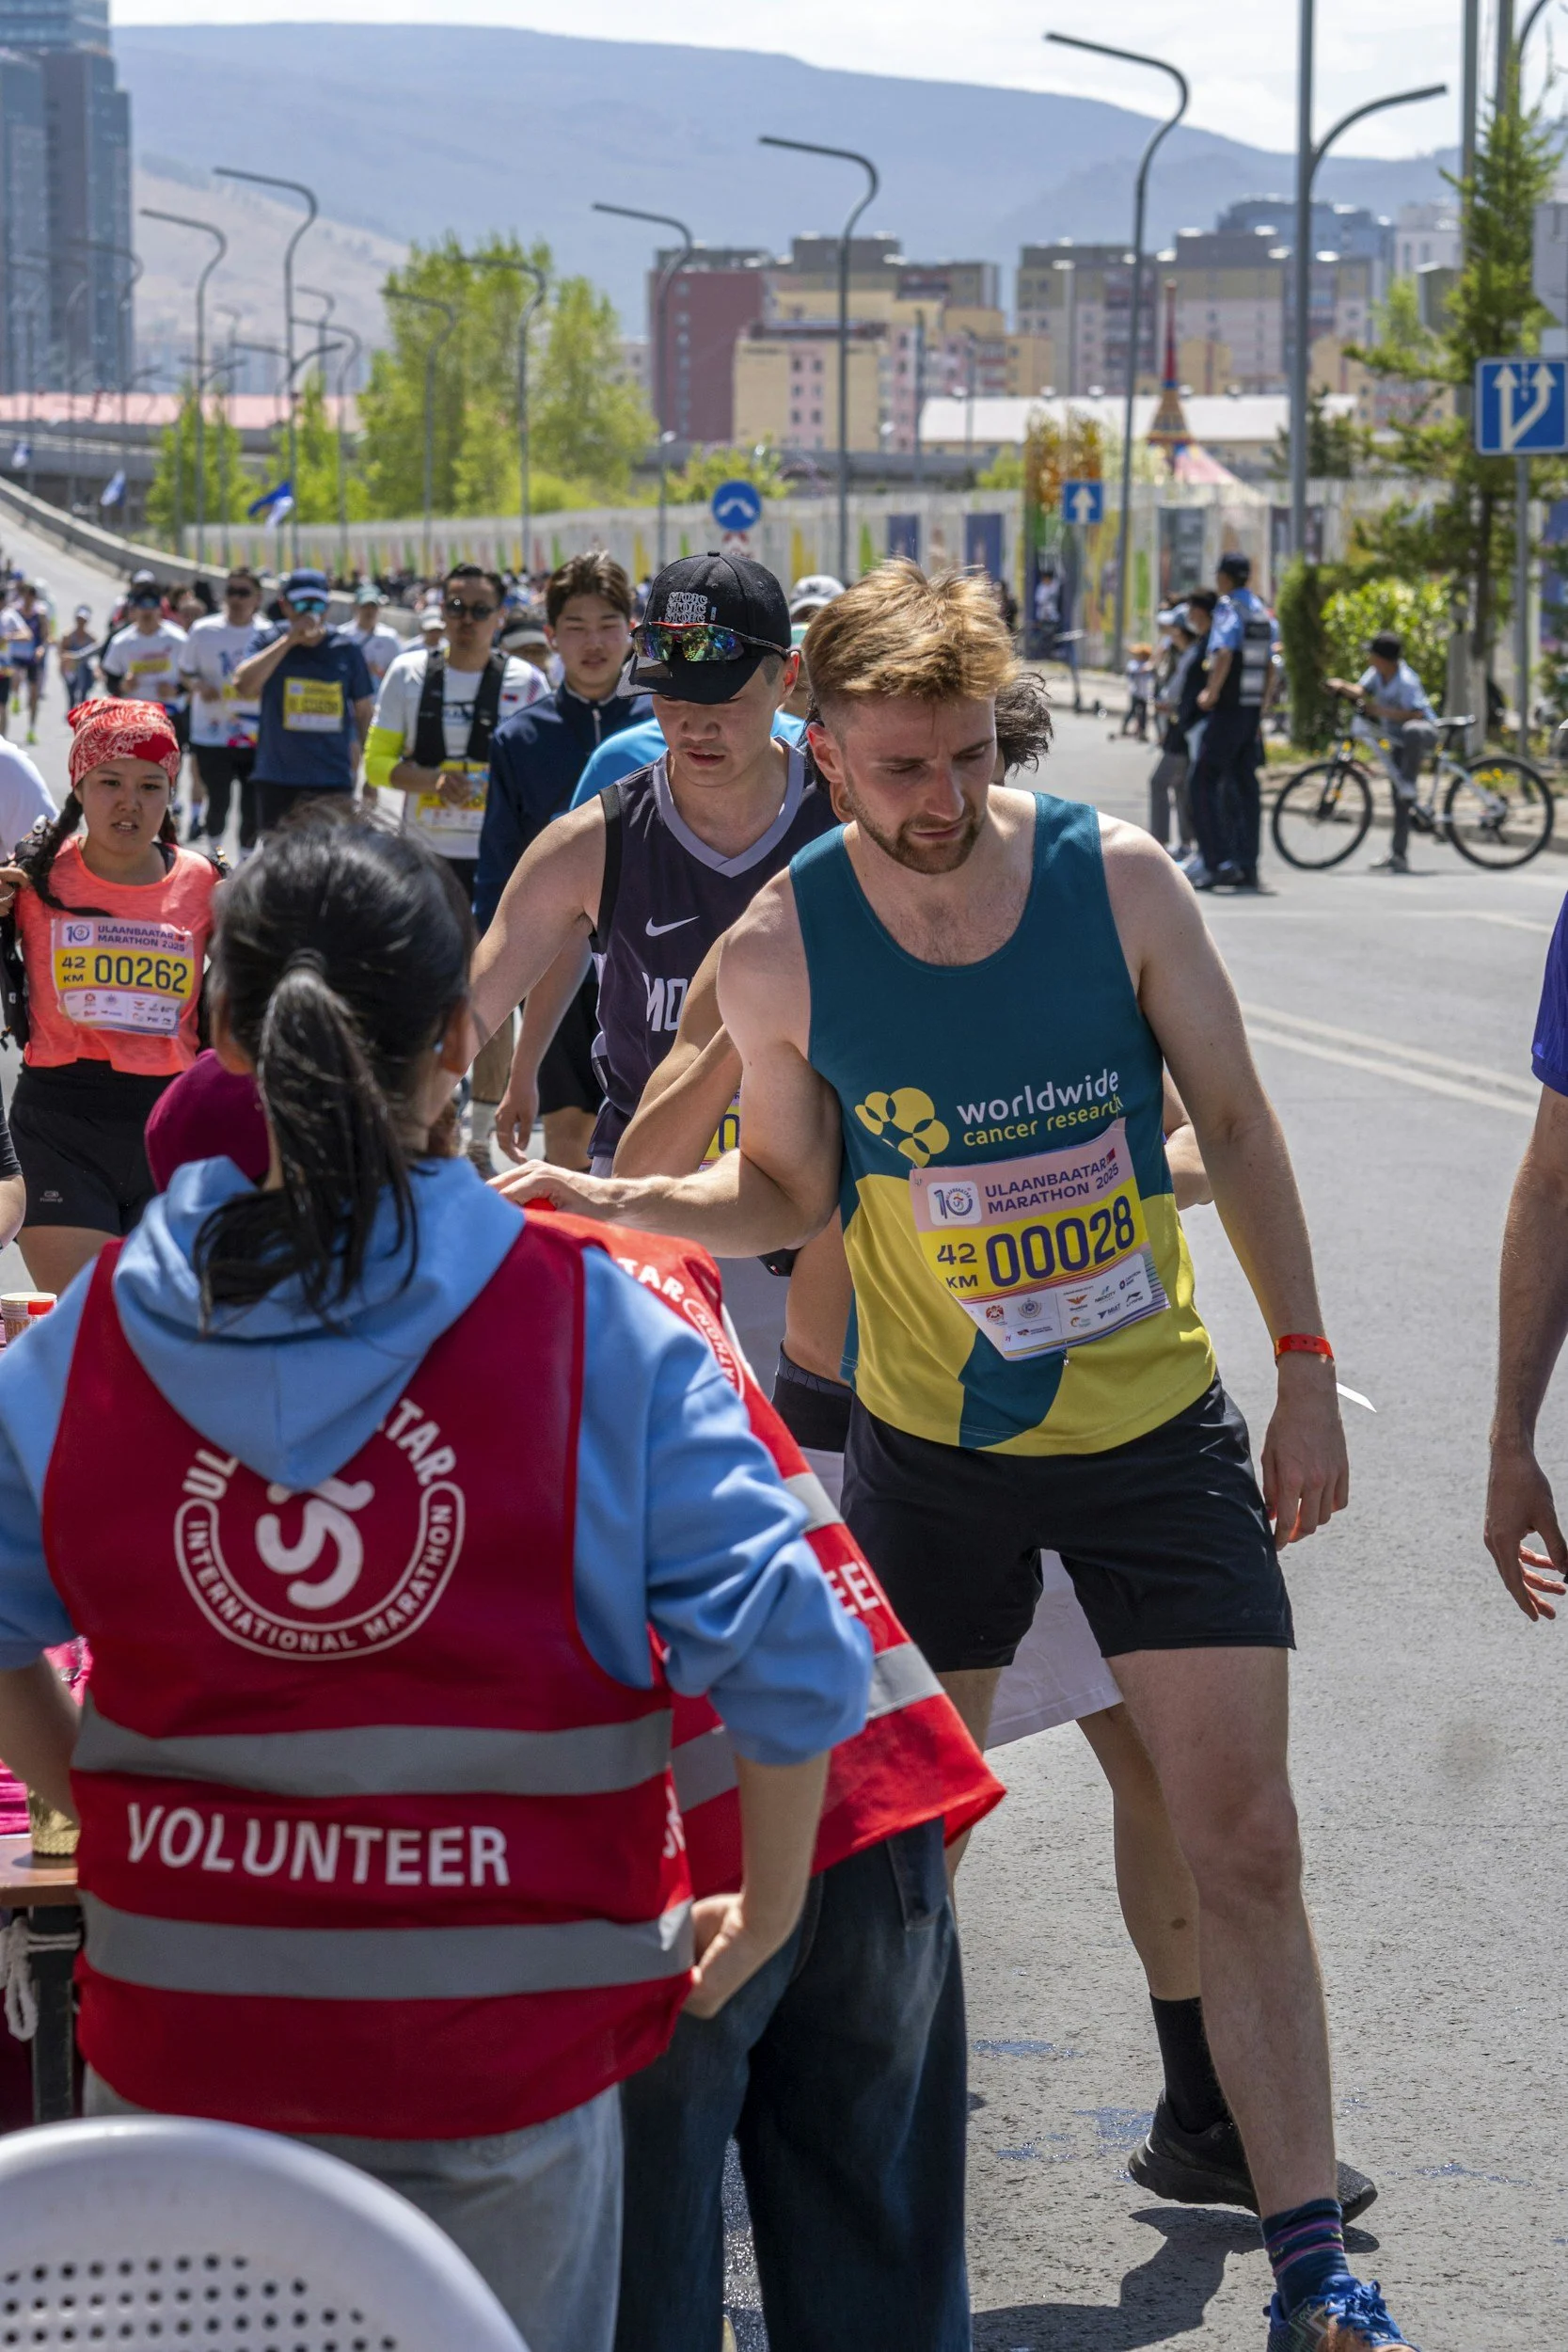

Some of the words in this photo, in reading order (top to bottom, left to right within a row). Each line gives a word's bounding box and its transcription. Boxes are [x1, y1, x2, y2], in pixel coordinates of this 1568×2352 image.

[666, 602, 706, 614] STOIC
[668, 592, 707, 605] STOIC
[98, 926, 173, 939] ULAANBAATAR
[98, 934, 158, 946] MARATHON
[62, 956, 86, 968] 42
[95, 955, 187, 993] 00262
[957, 1069, 1118, 1124] worldwide
[963, 1120, 1037, 1147] cancer
[1047, 1093, 1123, 1131] research
[985, 1158, 1106, 1198] ULAANBAATAR
[988, 1183, 1089, 1214] MARATHON
[1096, 1163, 1119, 1189] 2025
[937, 1243, 977, 1265] 42
[986, 1196, 1134, 1287] 00028
[945, 1275, 978, 1289] KM
[186, 1519, 358, 1653] INTERNATIONAL
[362, 1504, 452, 1642] MARATHON
[127, 1802, 510, 1887] VOLUNTEER
